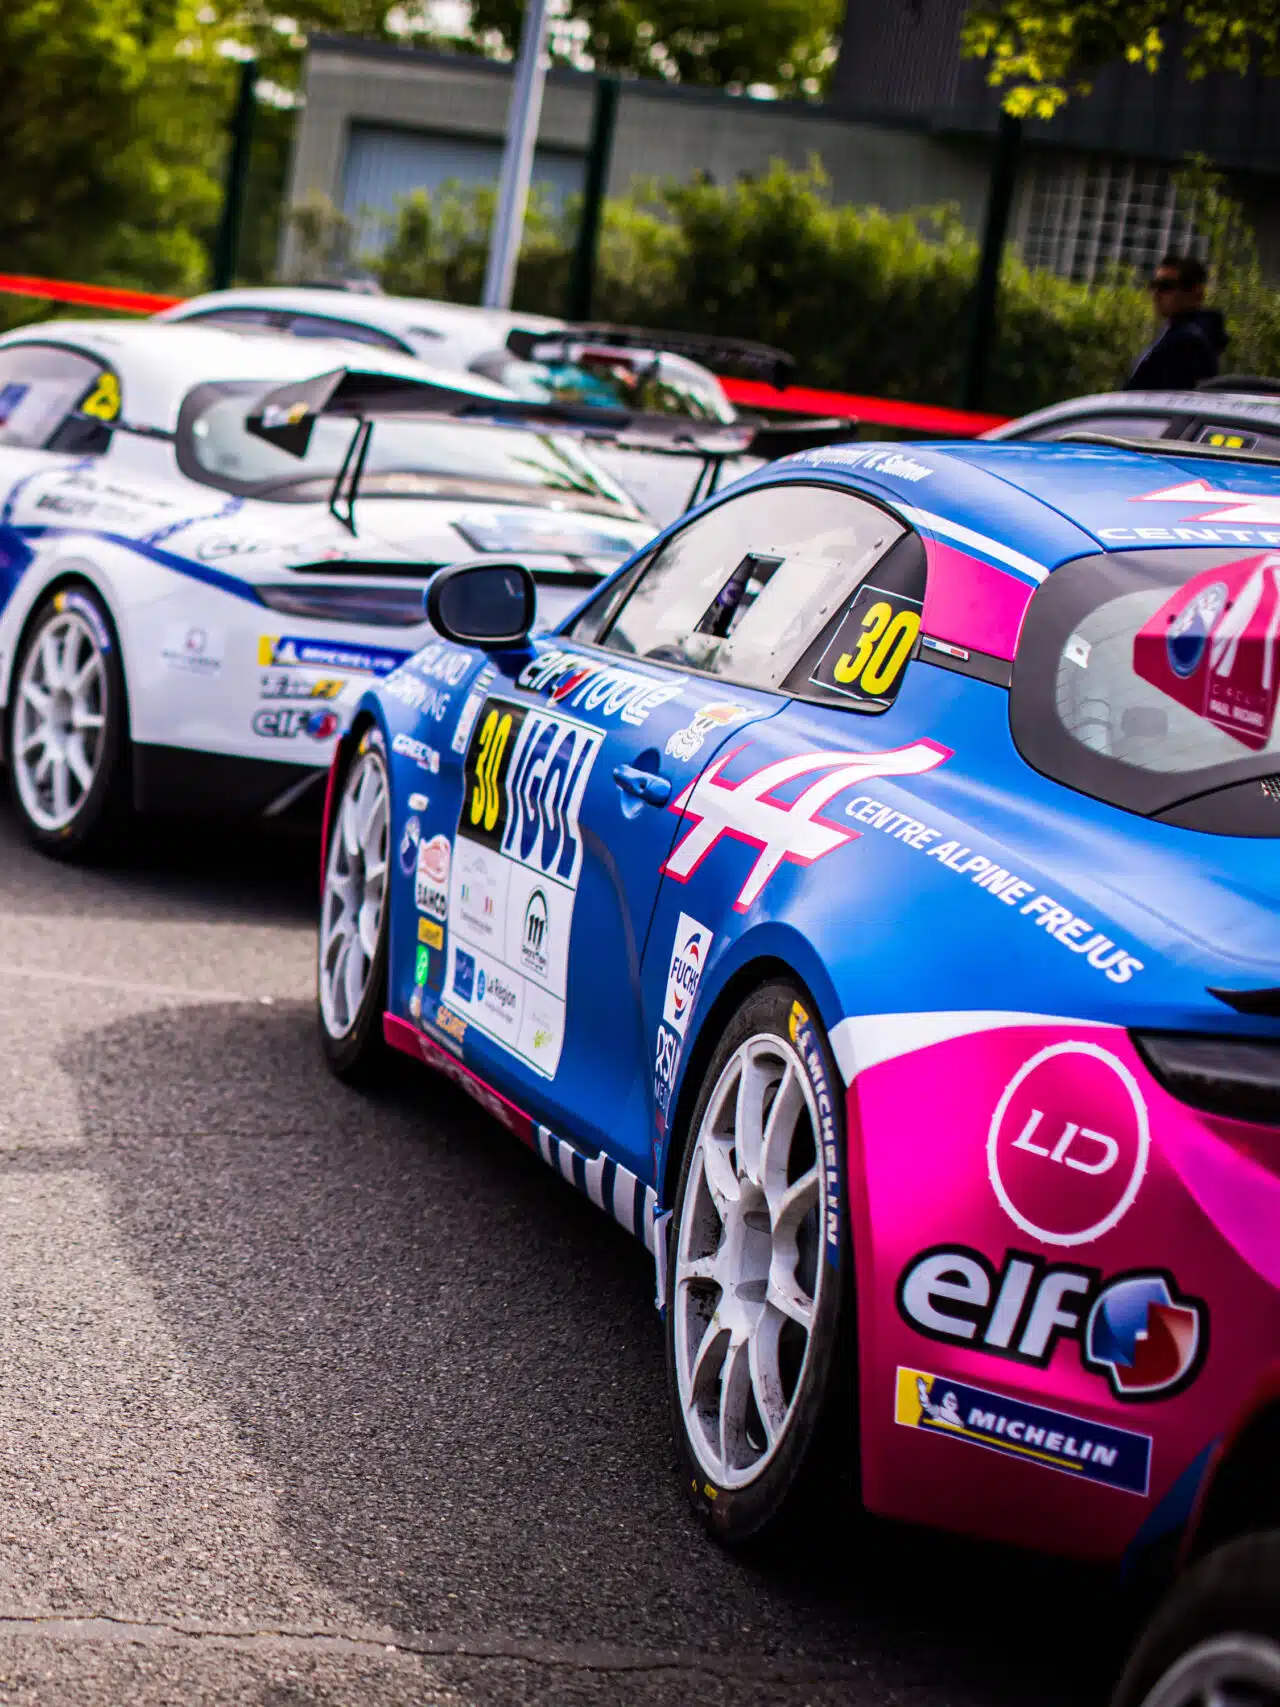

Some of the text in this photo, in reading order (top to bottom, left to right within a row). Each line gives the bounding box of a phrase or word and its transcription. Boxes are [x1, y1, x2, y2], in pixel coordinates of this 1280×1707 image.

[833, 601, 922, 695] 30
[471, 709, 514, 832] 30
[502, 718, 595, 881] IGOL
[845, 795, 1145, 985] CENTRE ALPINE FREJUS
[671, 957, 699, 997] FUCHS
[806, 1050, 840, 1247] MICHELIN
[901, 1252, 1091, 1360] elf
[968, 1406, 1118, 1468] MICHELIN
